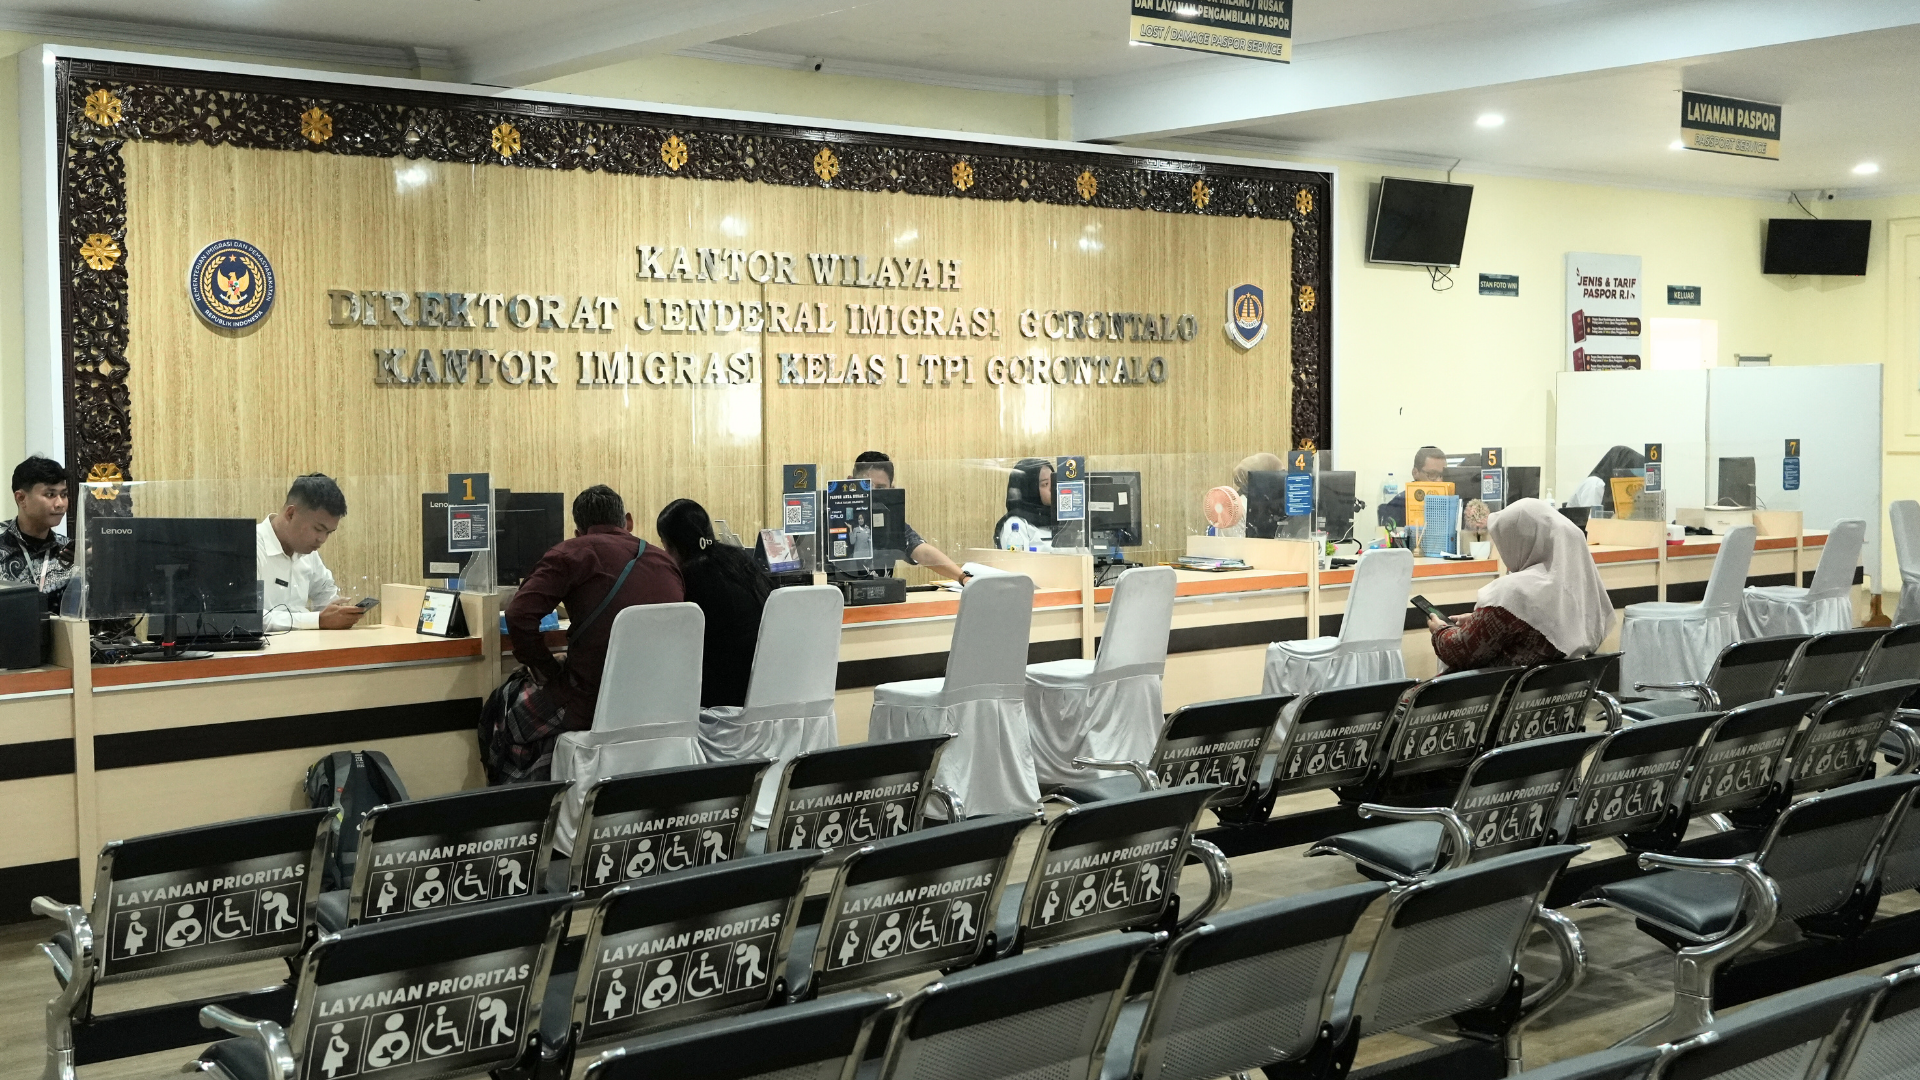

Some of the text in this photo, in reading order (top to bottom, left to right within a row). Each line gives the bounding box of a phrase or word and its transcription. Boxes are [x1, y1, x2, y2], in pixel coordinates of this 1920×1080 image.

[1135, 0, 1153, 9] DAN
[1198, 5, 1256, 25] PENGAMBILAN
[1258, 14, 1289, 31] PASPOR
[1258, 0, 1284, 13] RUSAK
[1140, 24, 1282, 55] LOST / DAMAGE PASPOR SERVICE
[1688, 101, 1775, 132] LAYANAN PASPOR
[1694, 133, 1767, 154] PASSPORT SERVICE
[193, 241, 274, 302] KEMENTERIAN IMIGRASI DAN PEMASYARAKATAN
[636, 245, 963, 290] KANTOR WILAYAH
[1494, 281, 1506, 289] FOTO
[1578, 276, 1637, 288] JENIS & TARIF
[1583, 288, 1630, 300] PASPOR R.I
[1674, 291, 1695, 300] KELUAR
[204, 309, 263, 327] REPUBLIK INDONESIA
[328, 289, 620, 331] DIREKTORAT
[636, 298, 836, 333] JENDERAL
[847, 303, 1001, 338] IMIGRASI
[1018, 309, 1199, 343] GORONTALO
[374, 347, 1170, 387] KANTOR IMIGRASI KELAS I TPI GORONTALO
[1488, 450, 1497, 466] 5
[1650, 446, 1658, 460] 6
[1789, 441, 1797, 455] 7
[1065, 459, 1077, 479] 3
[1295, 454, 1306, 471] 4
[463, 478, 475, 500] 1
[793, 468, 808, 488] 2
[101, 527, 133, 535] Lenovo
[1515, 689, 1588, 710] LAYANAN PRIORITAS
[1409, 703, 1489, 726] LAYANAN PRIORITAS
[1295, 721, 1382, 742] LAYANAN PRIORITAS
[1163, 738, 1260, 760] LAYANAN PRIORITAS
[1593, 760, 1681, 785] LAYANAN PRIORITAS
[789, 781, 919, 811] LAYANAN PRIORITAS
[1464, 782, 1560, 809] LAYANAN PRIORITAS
[593, 807, 739, 840] LAYANAN PRIORITAS
[374, 833, 538, 867] LAYANAN PRIORITAS
[1045, 838, 1178, 876] LAYANAN PRIORITAS
[117, 864, 305, 907] LAYANAN PRIORITAS
[842, 873, 992, 914] LAYANAN PRIORITAS
[602, 913, 781, 963] LAYANAN PRIORITAS
[319, 964, 530, 1017] LAYANAN PRIORITAS
